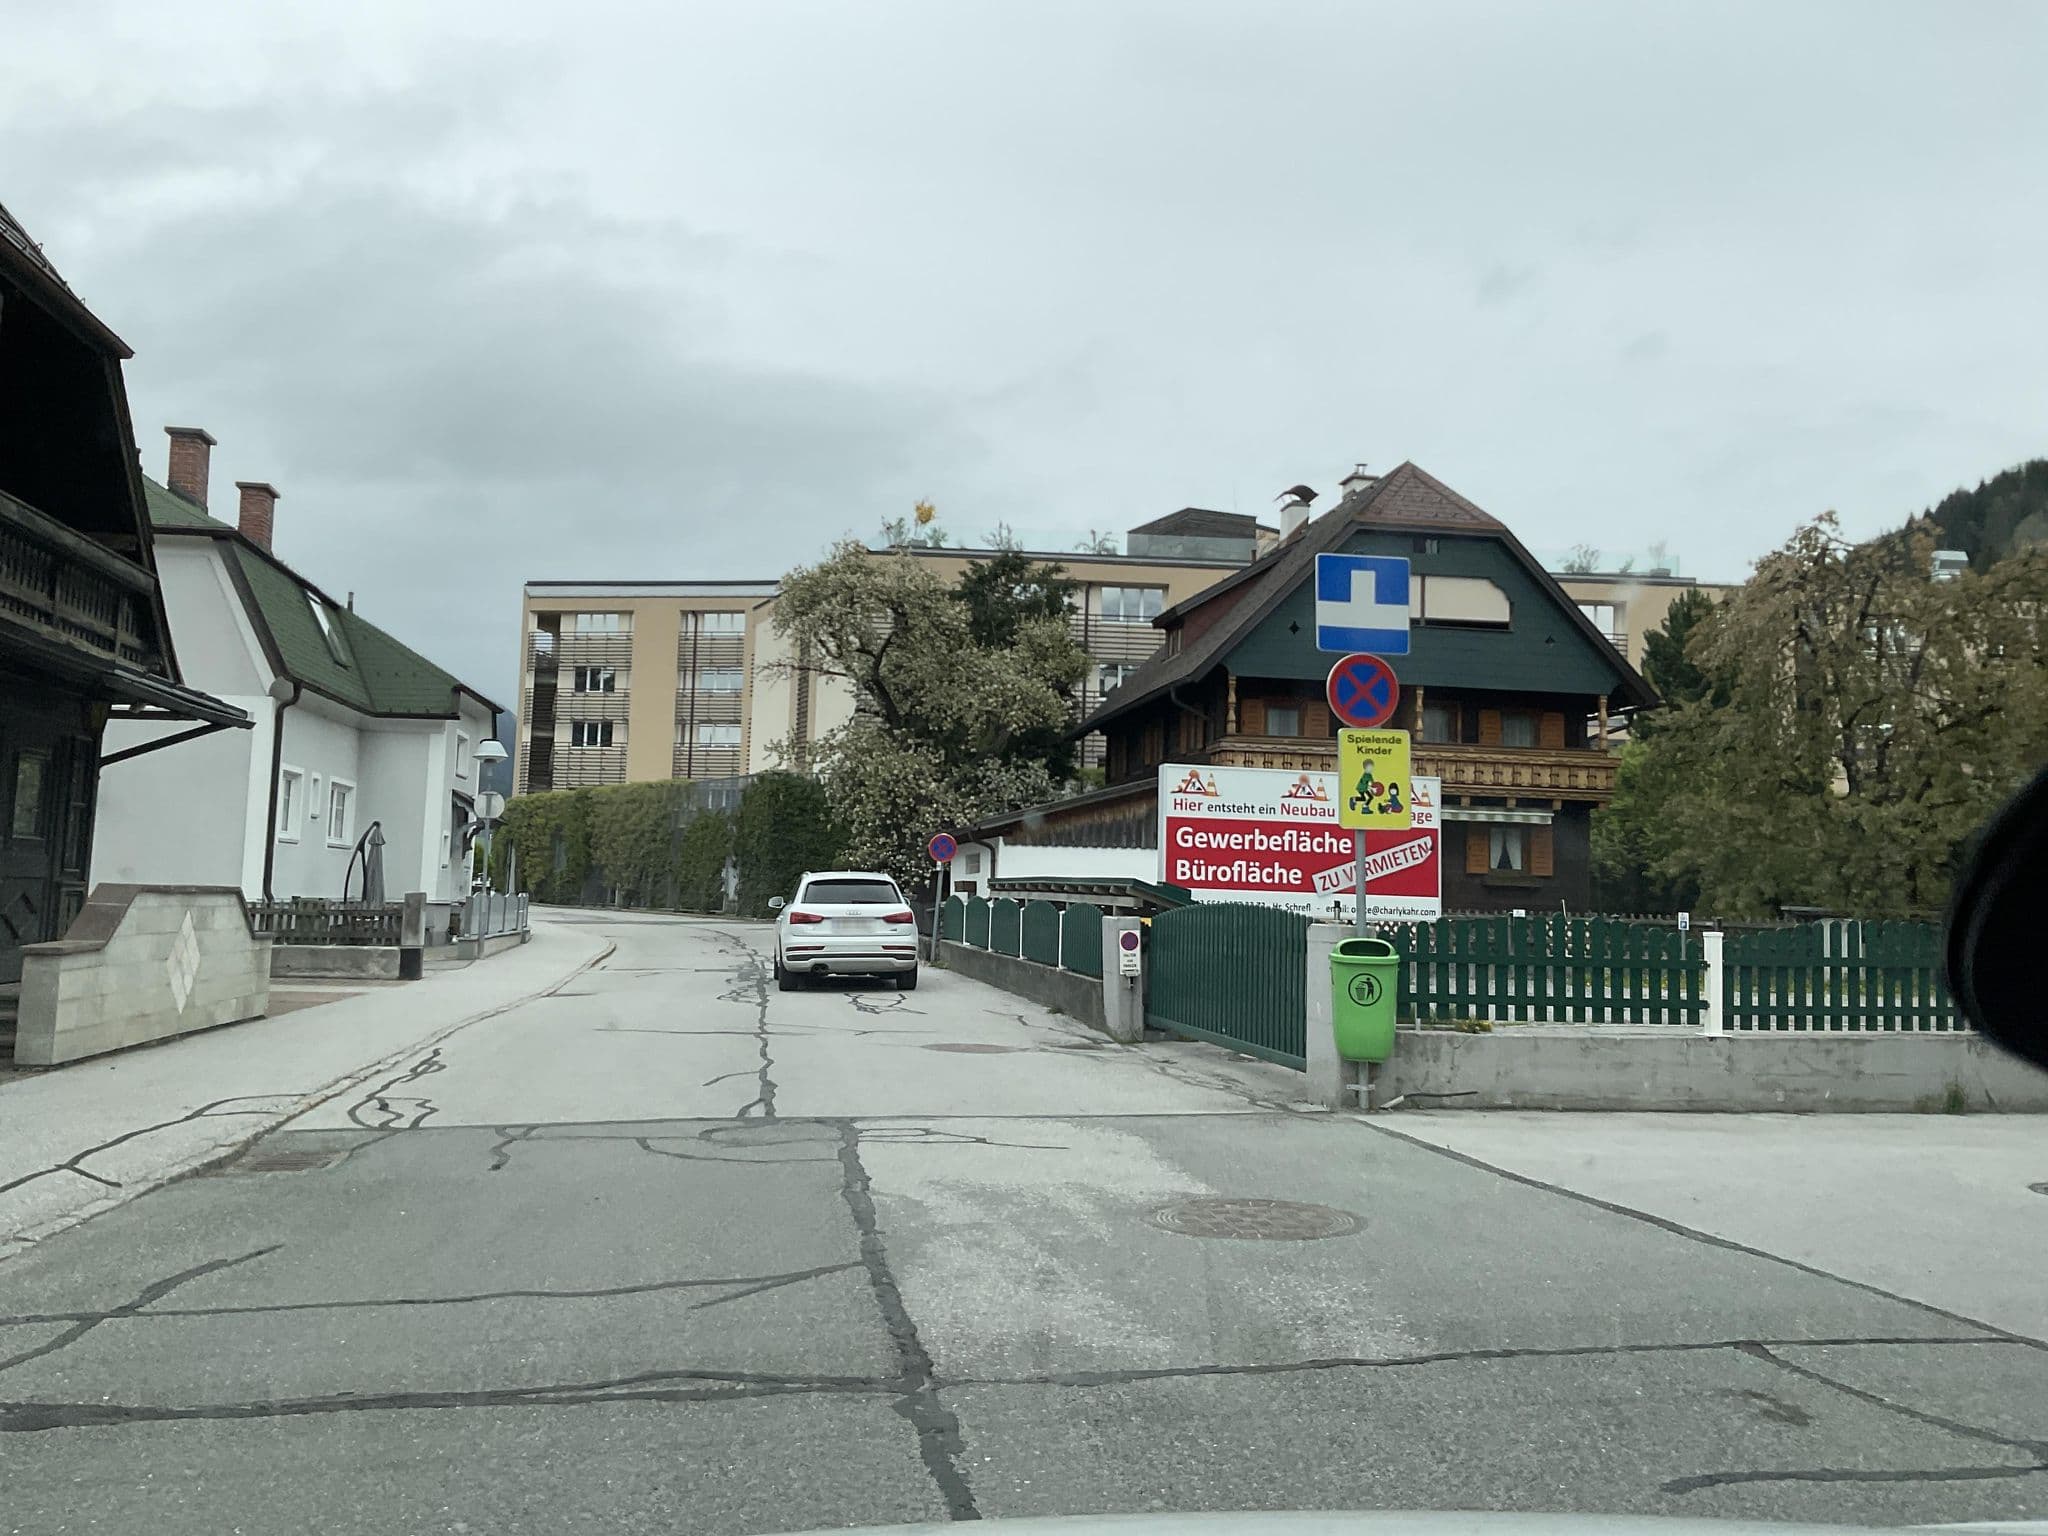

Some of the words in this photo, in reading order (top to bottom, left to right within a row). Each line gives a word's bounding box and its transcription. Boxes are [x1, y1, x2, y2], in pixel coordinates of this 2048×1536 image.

[1347, 735, 1402, 744] Spielende
[1357, 747, 1392, 755] Kinder
[1173, 798, 1203, 811] Hier
[1207, 803, 1255, 814] entsteht
[1259, 804, 1275, 815] ein
[1280, 803, 1335, 817] Neubau
[1175, 826, 1352, 853] Gewerbefläche
[1176, 859, 1302, 884] Bürofläche
[1319, 871, 1340, 891] ZU
[1342, 841, 1429, 882] VRMIETEN
